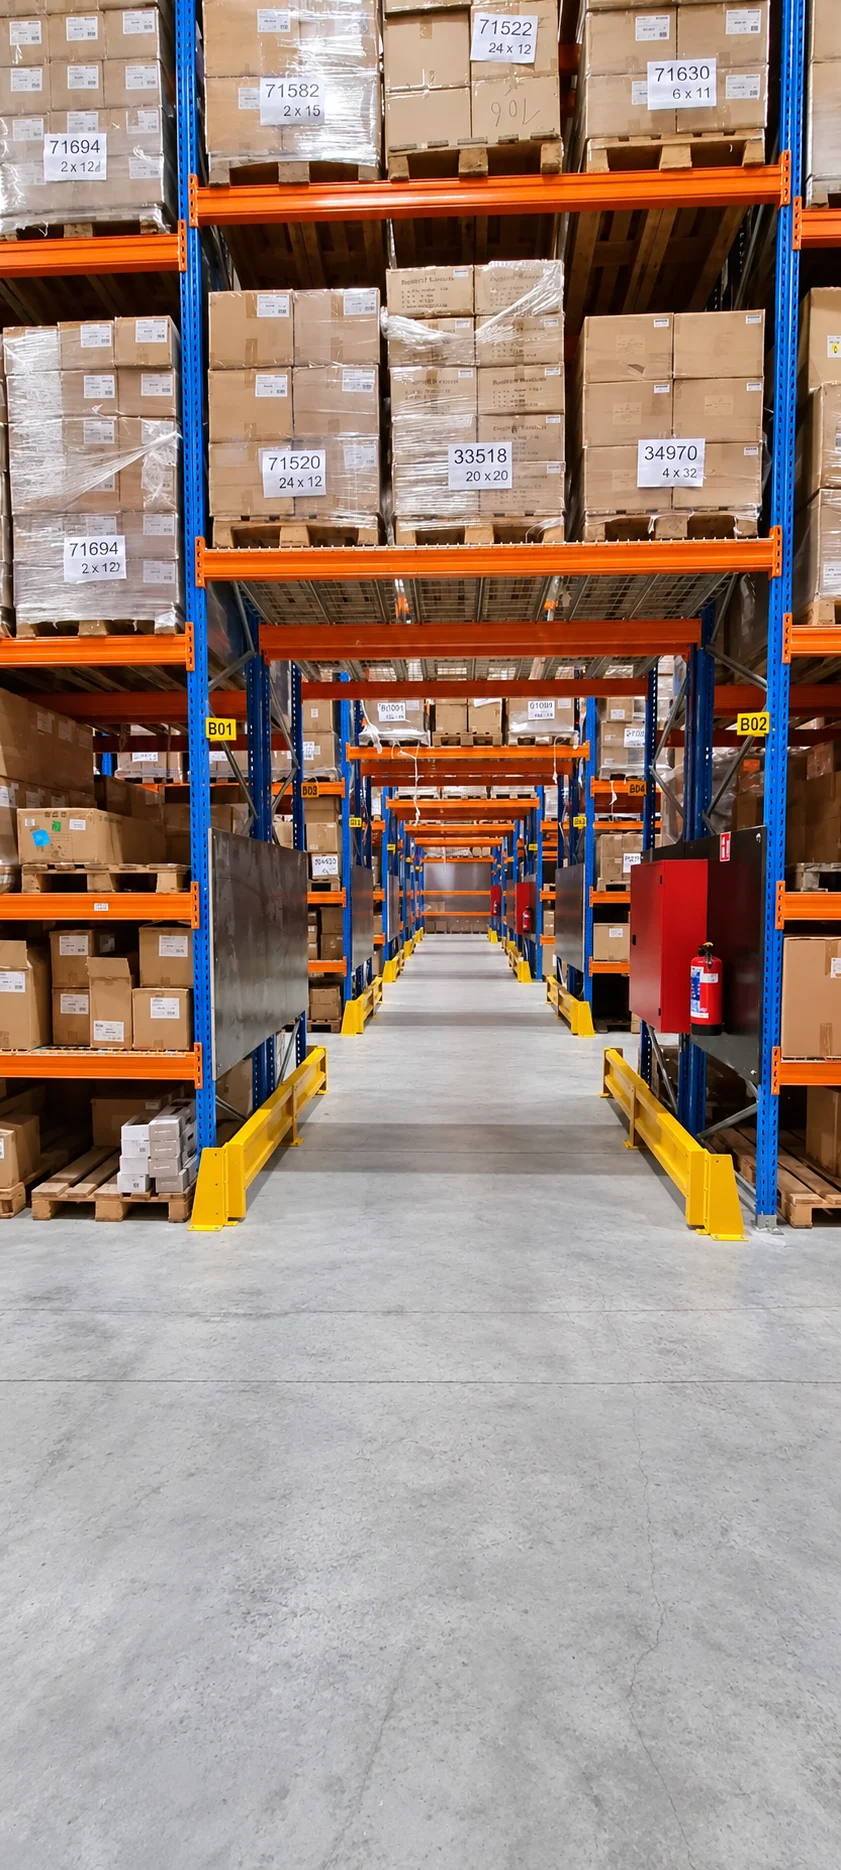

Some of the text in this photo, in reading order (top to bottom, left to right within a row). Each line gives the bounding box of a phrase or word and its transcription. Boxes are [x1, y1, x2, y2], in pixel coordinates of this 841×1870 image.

[479, 18, 533, 37] 71522
[488, 41, 532, 55] 24 x 12
[654, 65, 710, 82] 71630
[265, 82, 320, 98] 71582
[672, 86, 710, 100] 6 x 11
[283, 104, 321, 117] 2 x 15
[49, 139, 101, 155] 71694
[60, 160, 69, 173] 2
[70, 163, 77, 173] x
[454, 447, 508, 465] 33518
[644, 445, 698, 461] 34970
[268, 455, 321, 471] 71520
[465, 469, 508, 482] 20 x 20
[662, 467, 697, 479] 4 x 32
[279, 475, 323, 489] 24 x 12
[69, 541, 119, 557] 71694
[81, 562, 90, 574] 2
[91, 564, 100, 574] x
[208, 721, 232, 736] B01
[740, 716, 767, 732] B02
